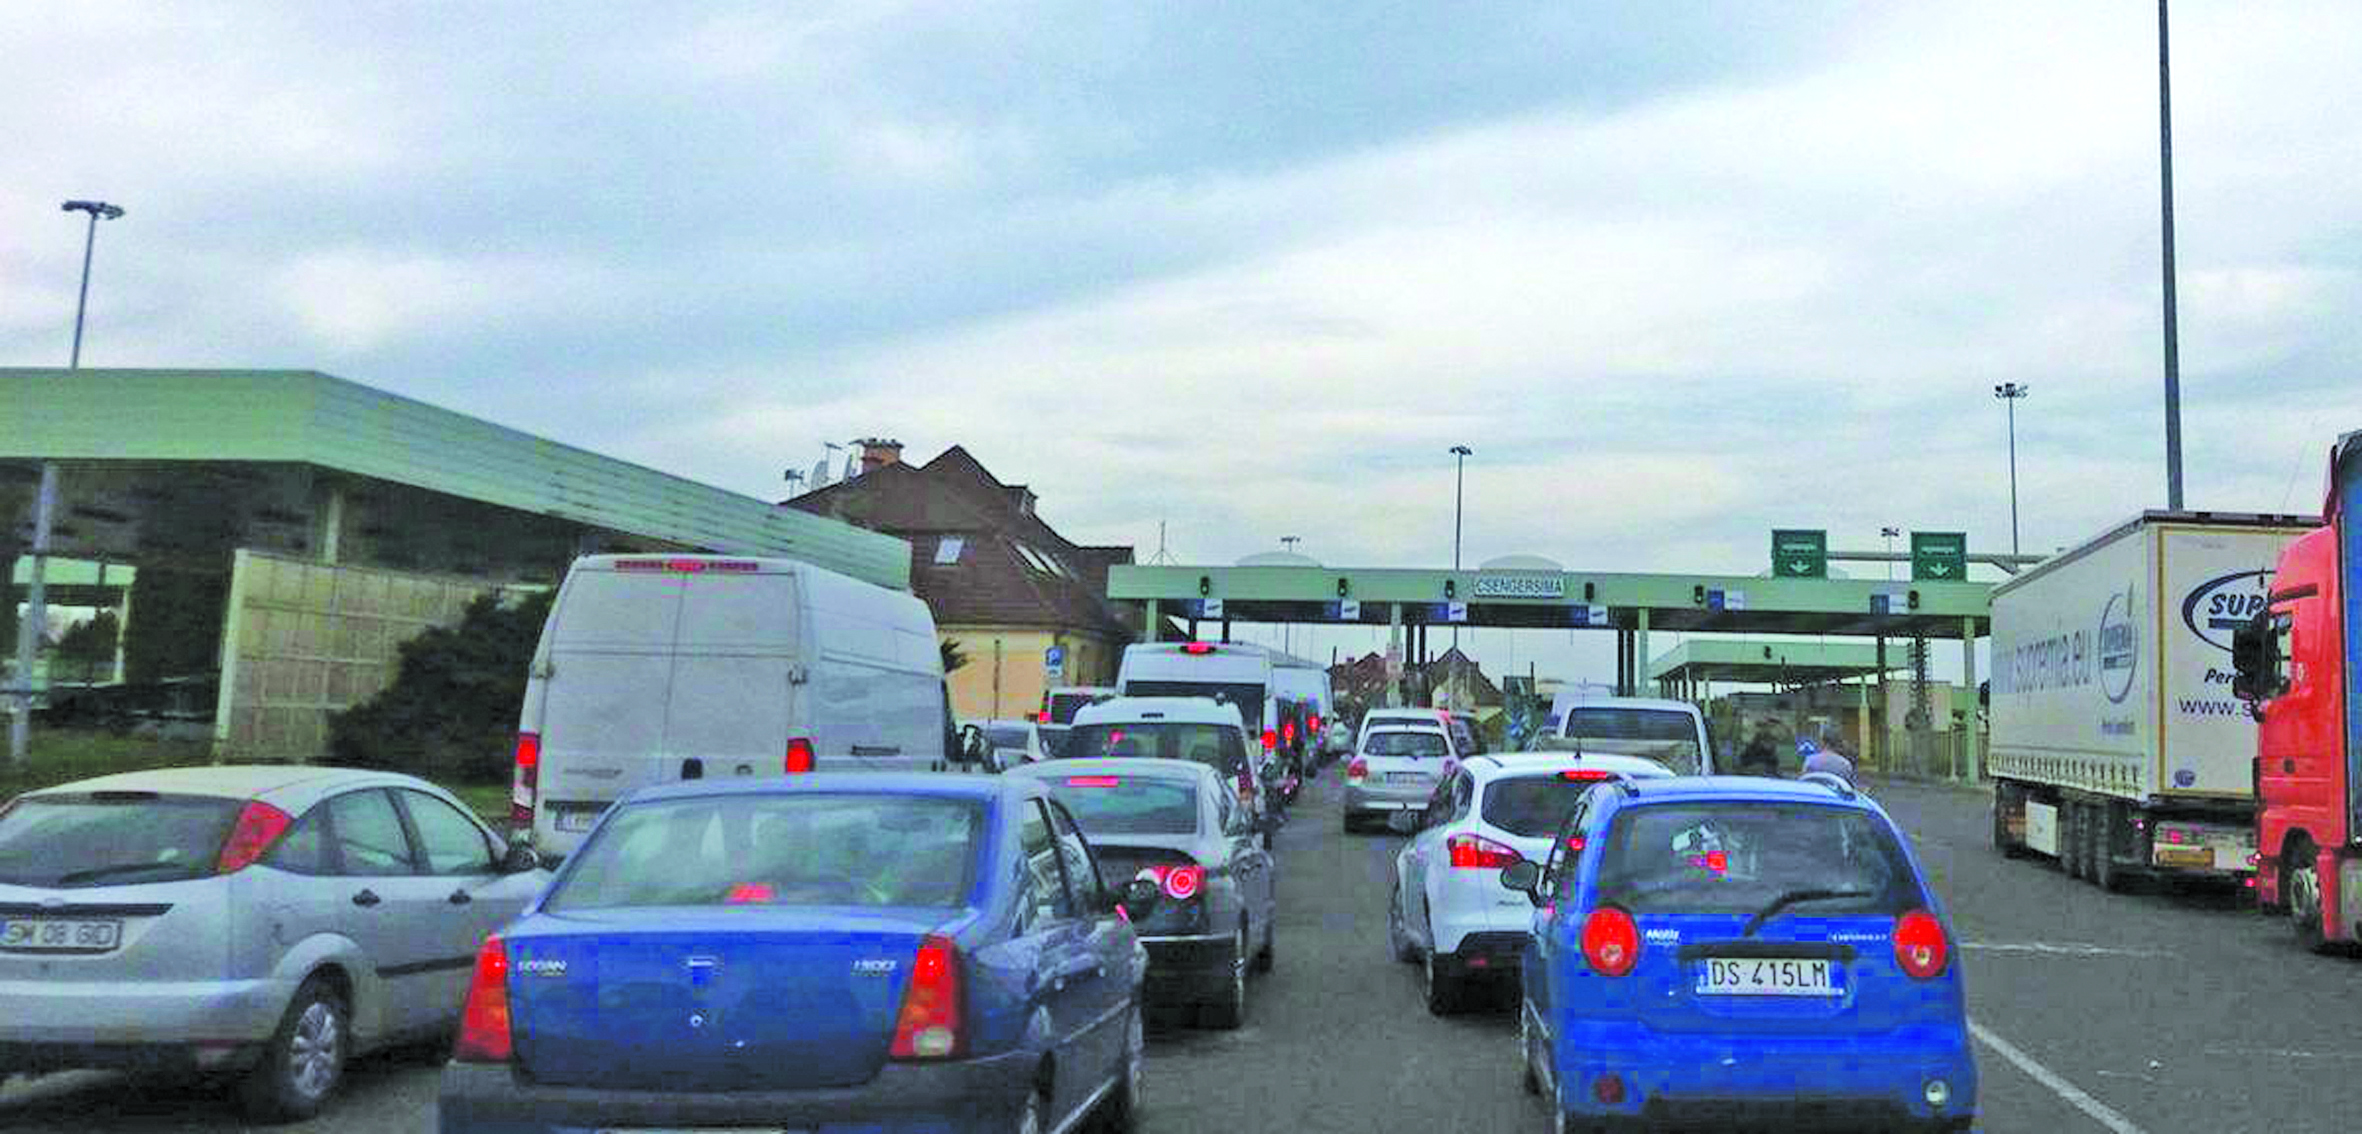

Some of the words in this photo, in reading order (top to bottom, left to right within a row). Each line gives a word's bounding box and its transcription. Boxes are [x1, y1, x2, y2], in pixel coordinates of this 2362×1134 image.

[1475, 577, 1564, 595] CSENGERSIMA
[1712, 961, 1741, 986] DS
[1751, 961, 1827, 987] 415LM
